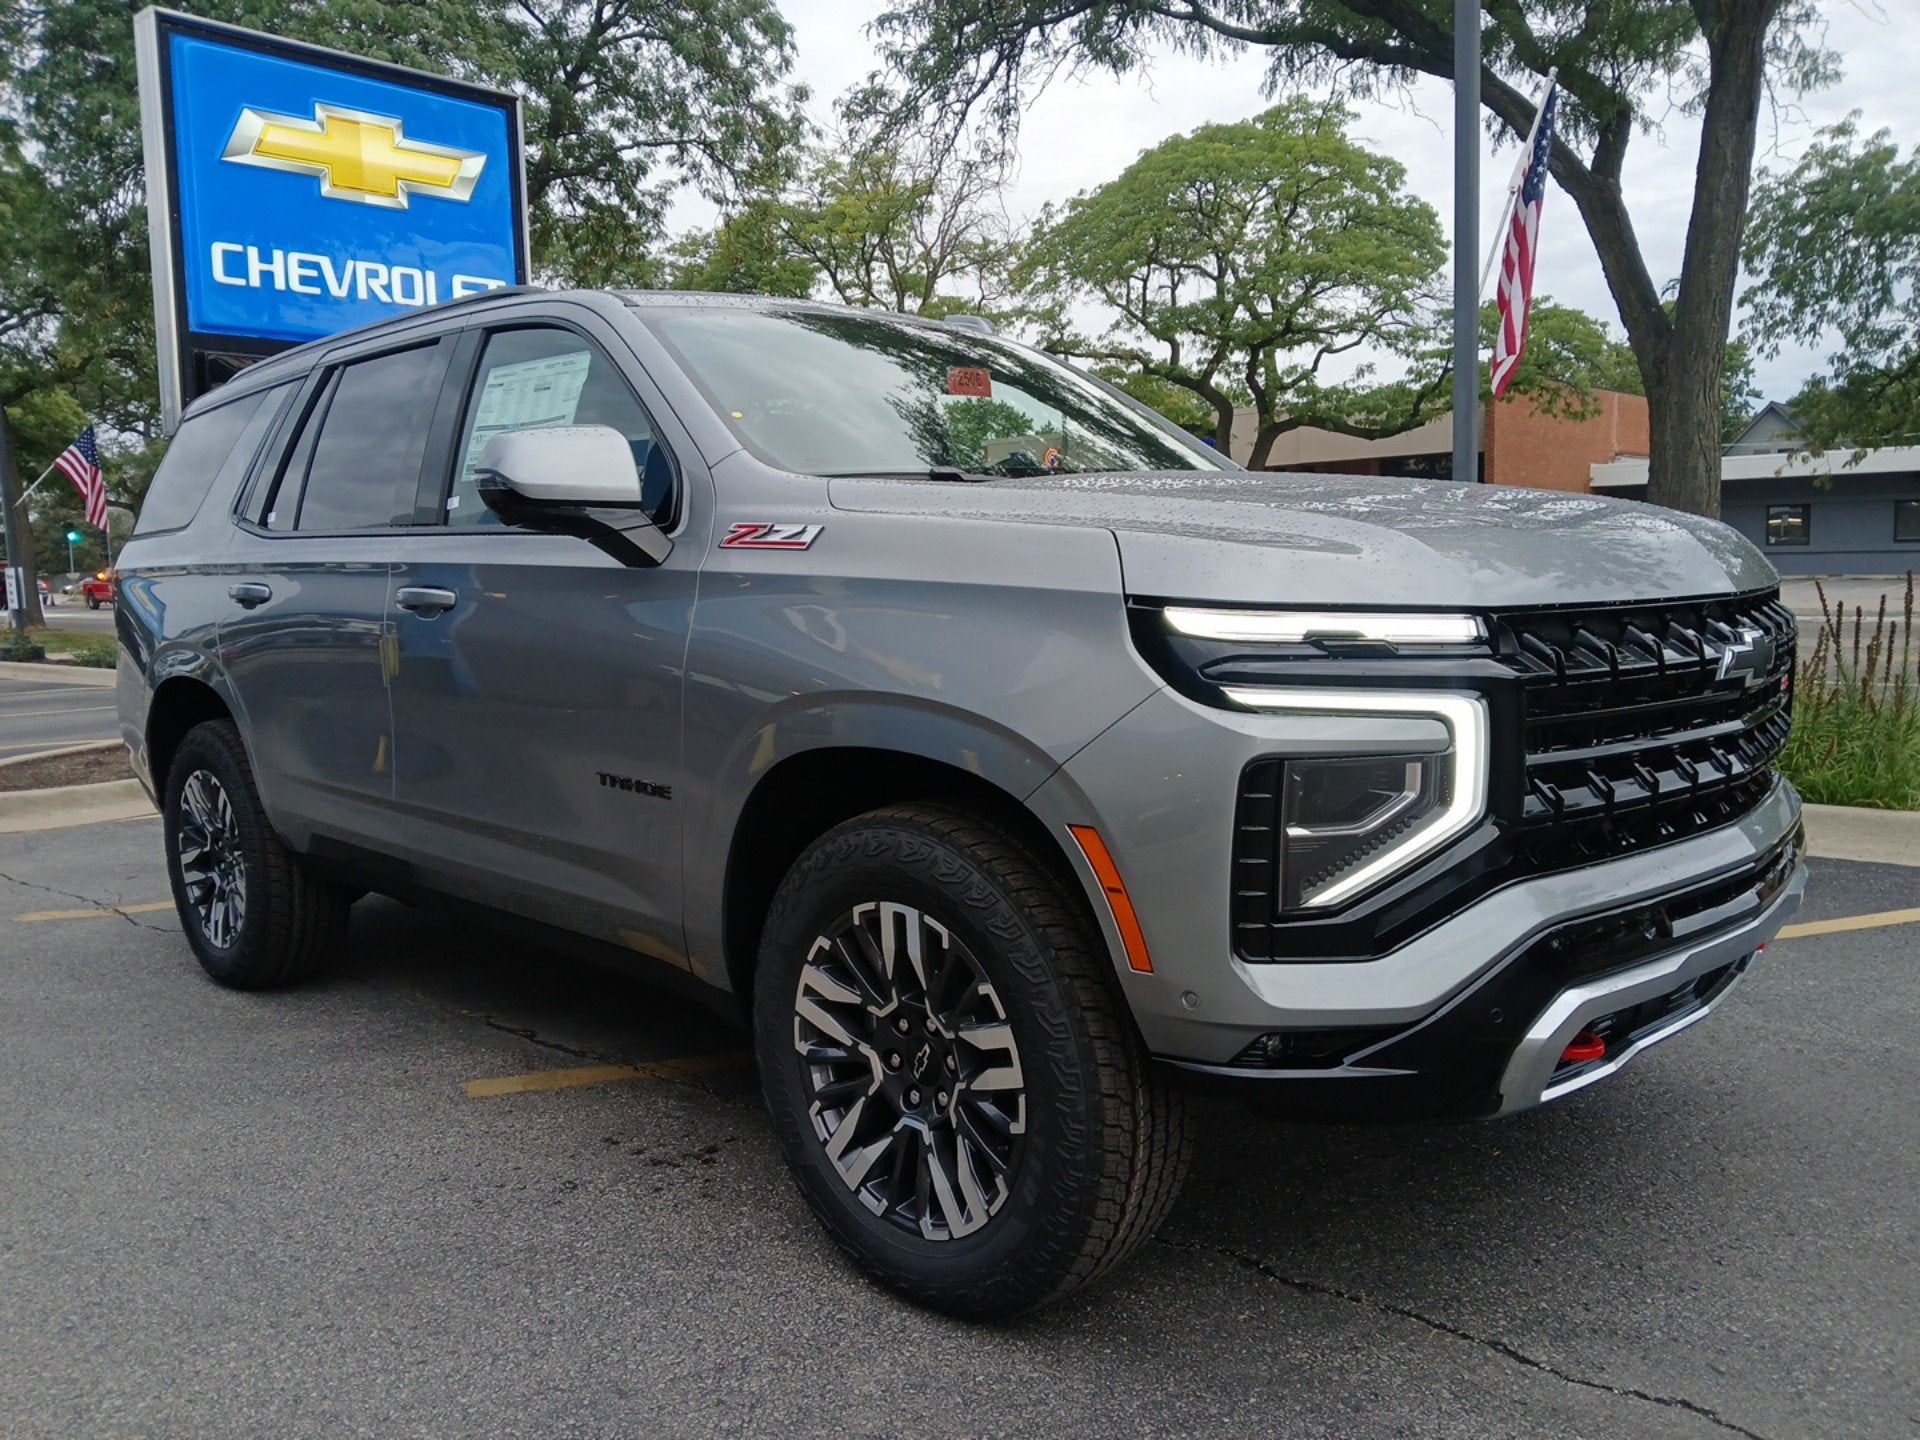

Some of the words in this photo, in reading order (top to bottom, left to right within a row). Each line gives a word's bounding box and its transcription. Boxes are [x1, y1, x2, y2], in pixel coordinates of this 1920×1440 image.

[211, 242, 507, 306] CHEVROLE
[719, 522, 825, 551] Z71
[596, 770, 672, 800] TAHOE
